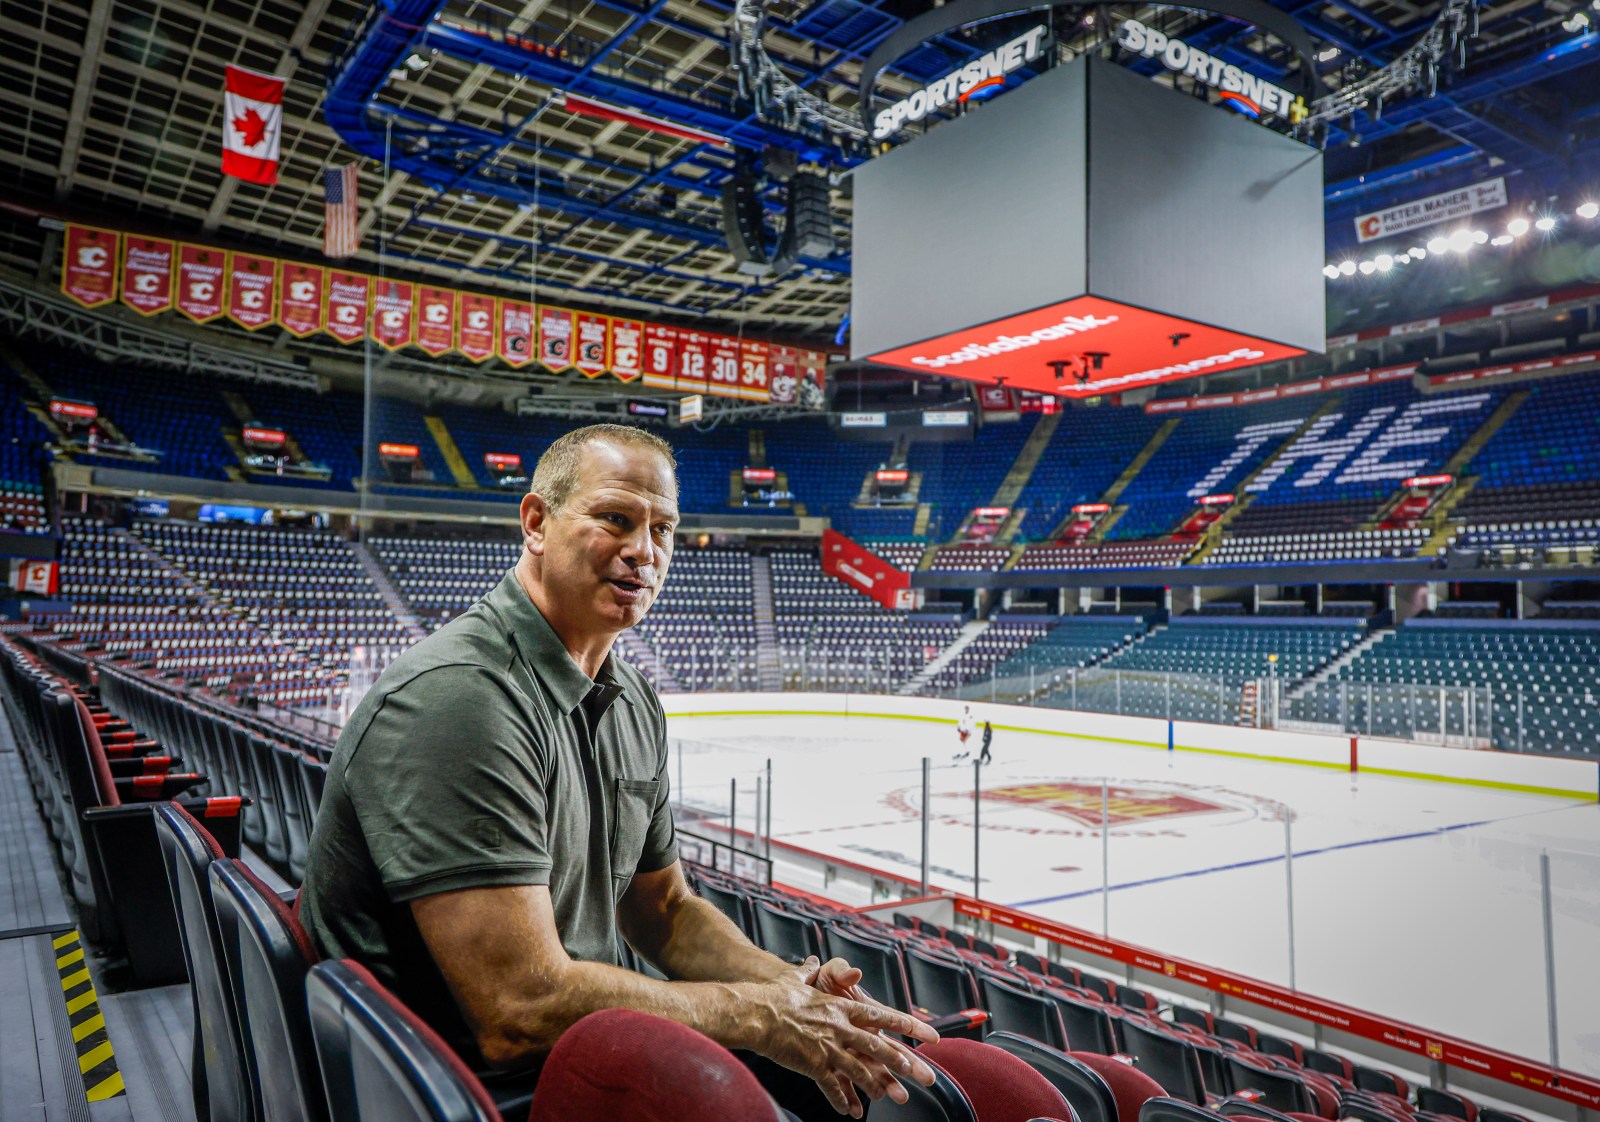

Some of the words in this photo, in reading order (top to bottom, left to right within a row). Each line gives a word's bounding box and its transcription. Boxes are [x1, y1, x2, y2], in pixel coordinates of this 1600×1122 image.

[873, 24, 1046, 140] SPORTSNET
[1383, 205, 1421, 223] PETER
[1425, 191, 1469, 211] MAHER
[653, 347, 667, 372] 9
[681, 351, 705, 378] 12
[712, 356, 738, 382] 30
[742, 361, 767, 387] 34
[1187, 392, 1490, 497] THE
